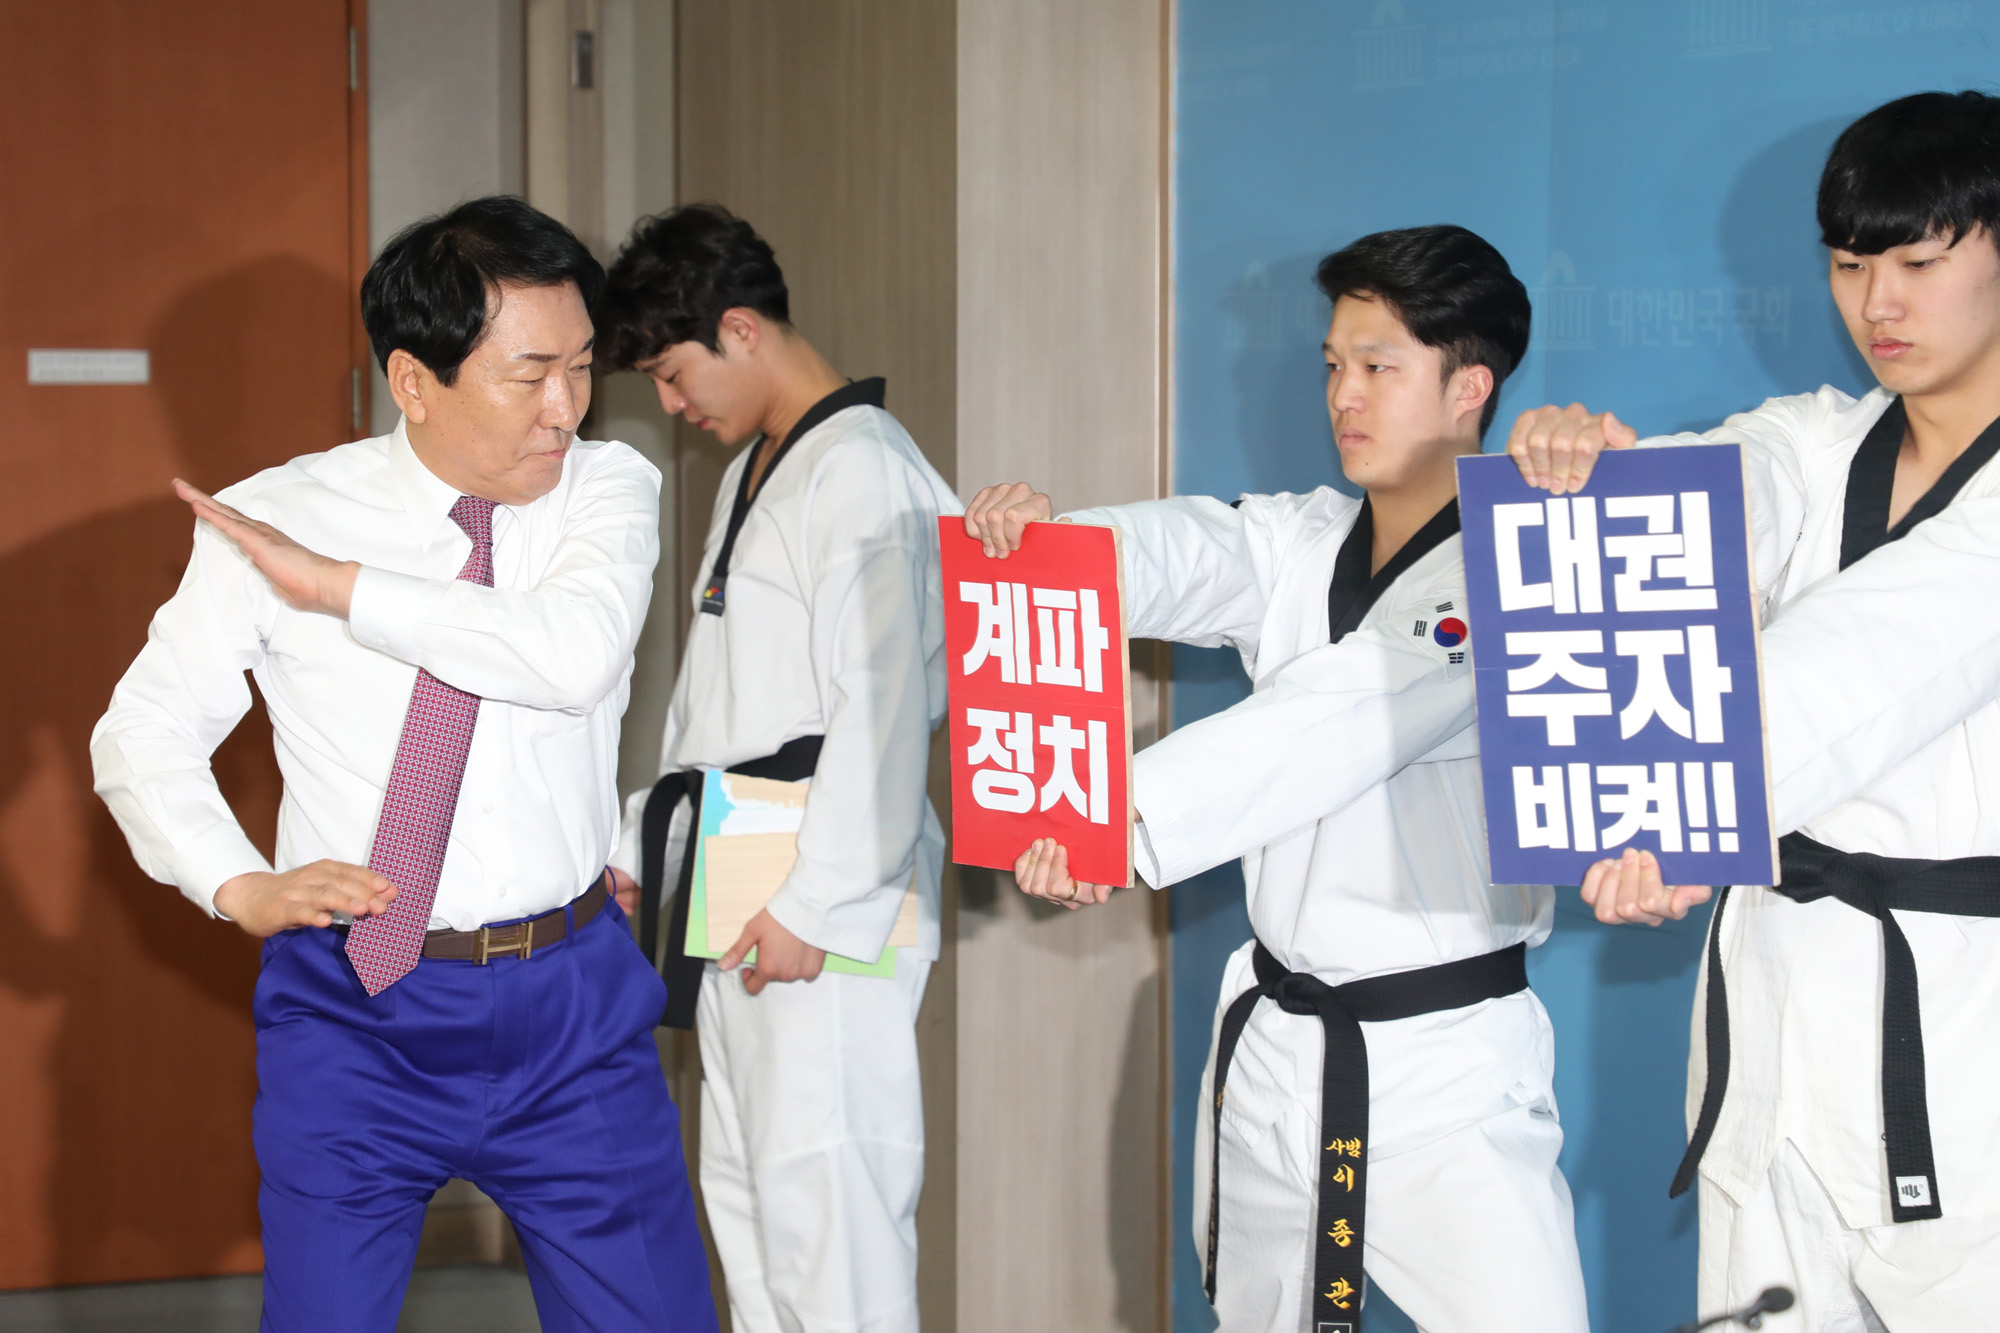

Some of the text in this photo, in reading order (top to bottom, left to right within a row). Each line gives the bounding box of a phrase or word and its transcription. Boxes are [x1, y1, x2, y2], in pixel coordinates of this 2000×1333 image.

[1493, 491, 1718, 614] 대권
[959, 581, 1109, 693] 계파
[1504, 625, 1732, 746] 주자
[966, 707, 1109, 825] 정치
[1512, 761, 1739, 853] 비켜!!
[1325, 1137, 1362, 1158] 사범
